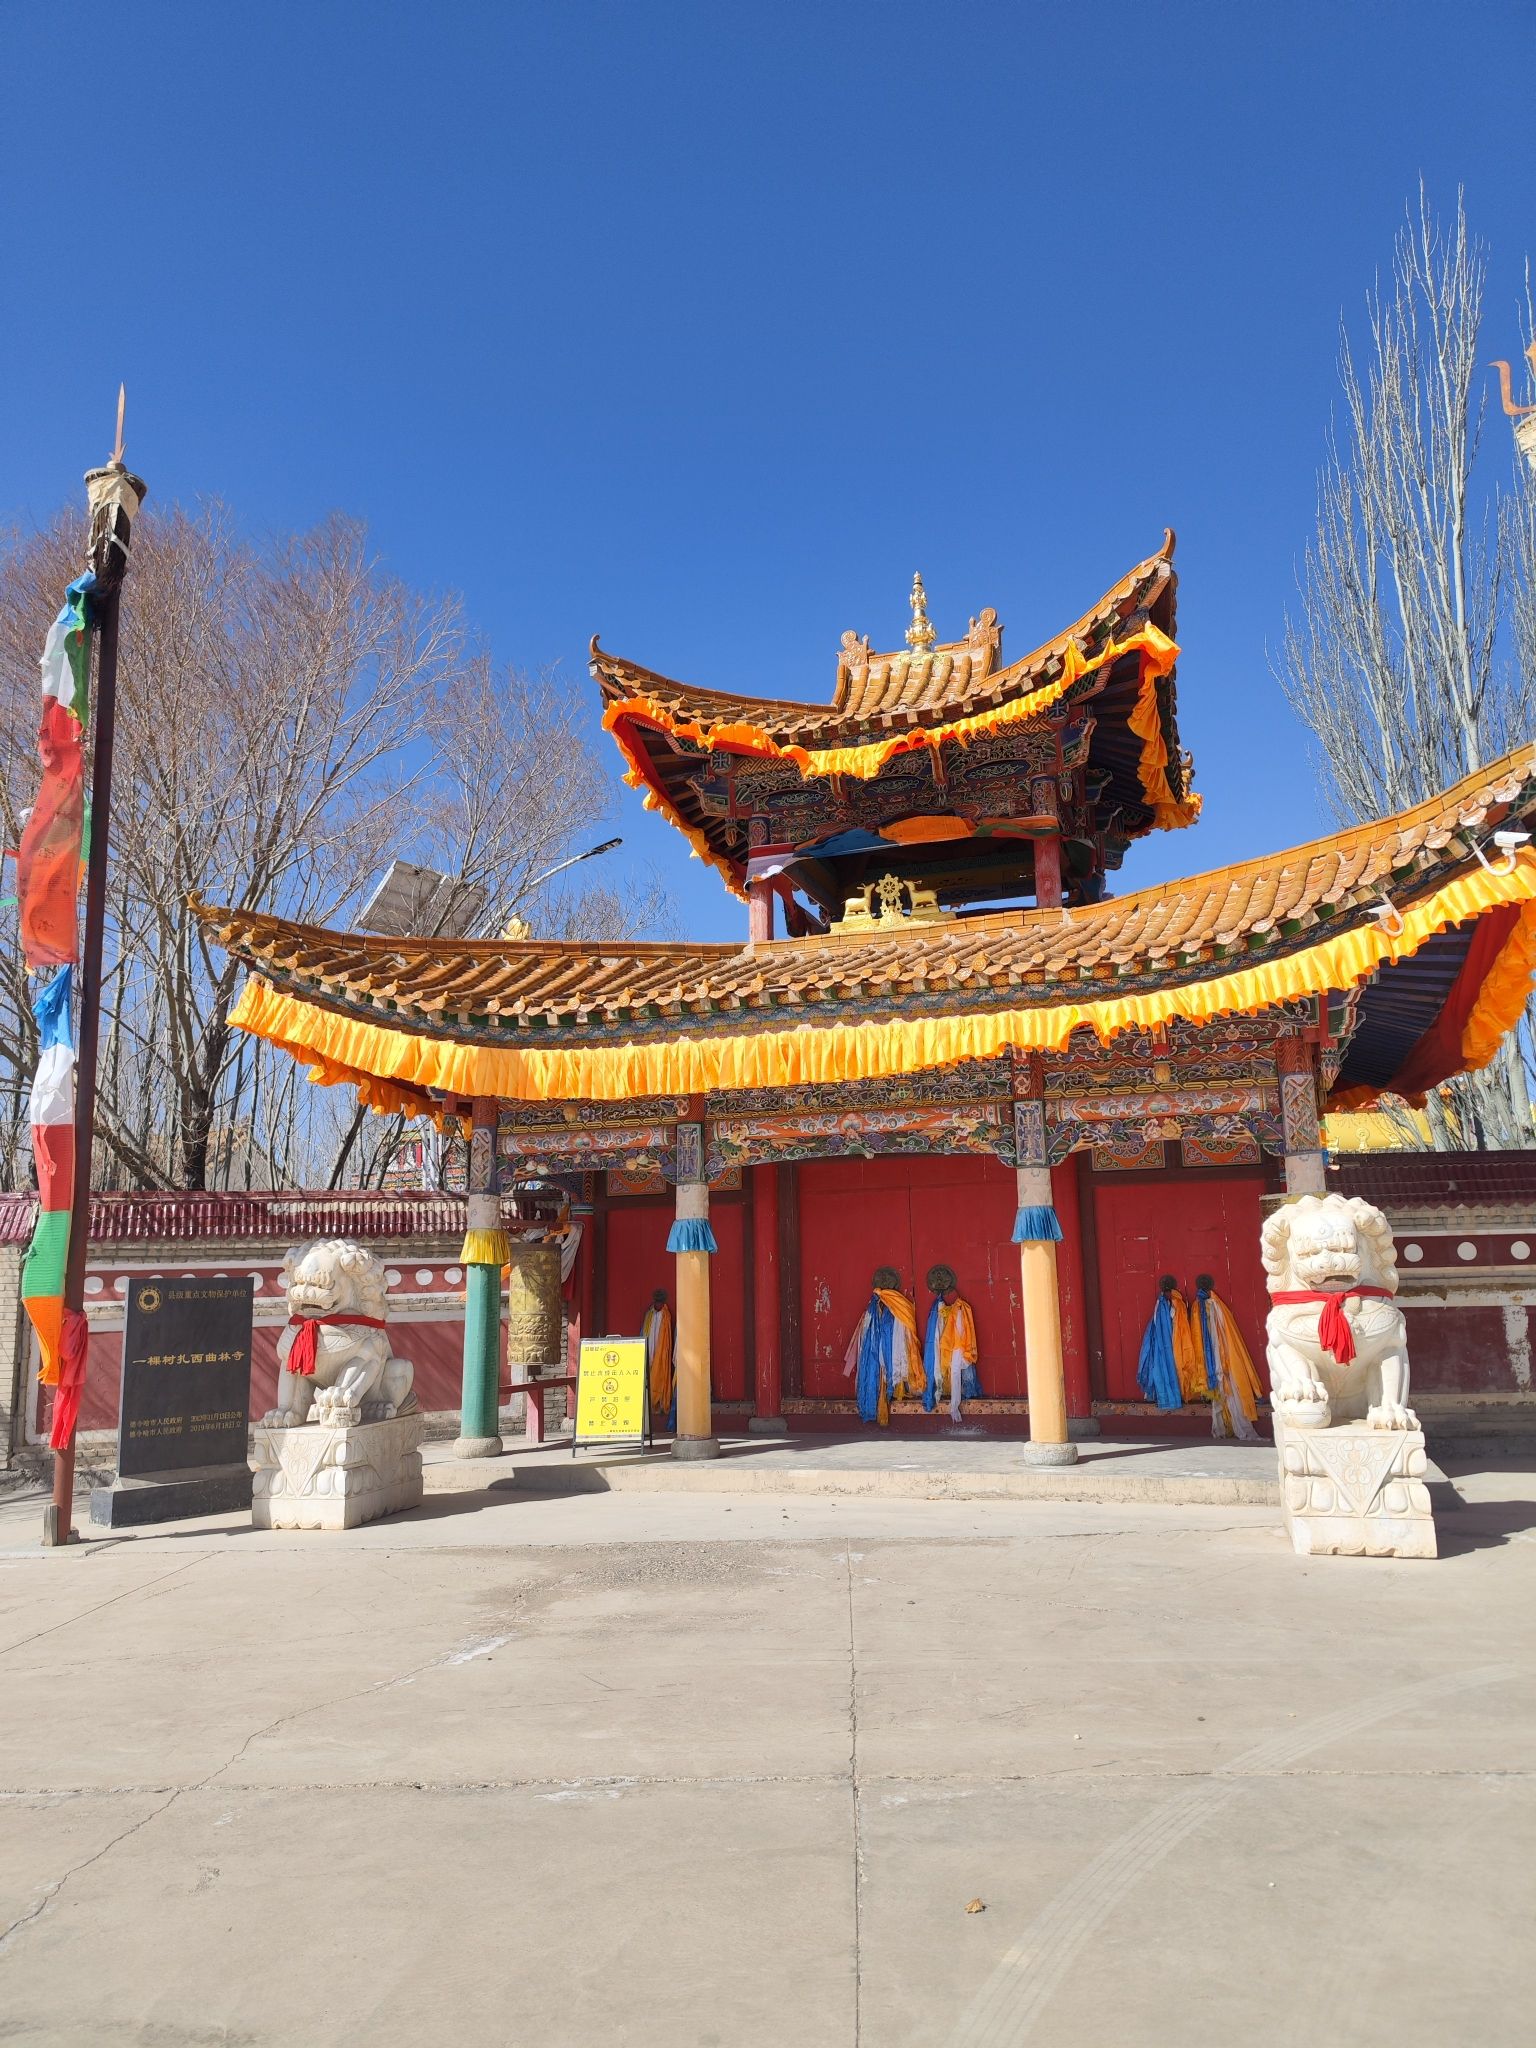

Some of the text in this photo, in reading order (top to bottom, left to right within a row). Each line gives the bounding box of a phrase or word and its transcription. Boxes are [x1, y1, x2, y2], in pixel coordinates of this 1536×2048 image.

[168, 1289, 248, 1300] 县级重点文物保护单位
[132, 1350, 245, 1366] 一棵树扎西曲林寺
